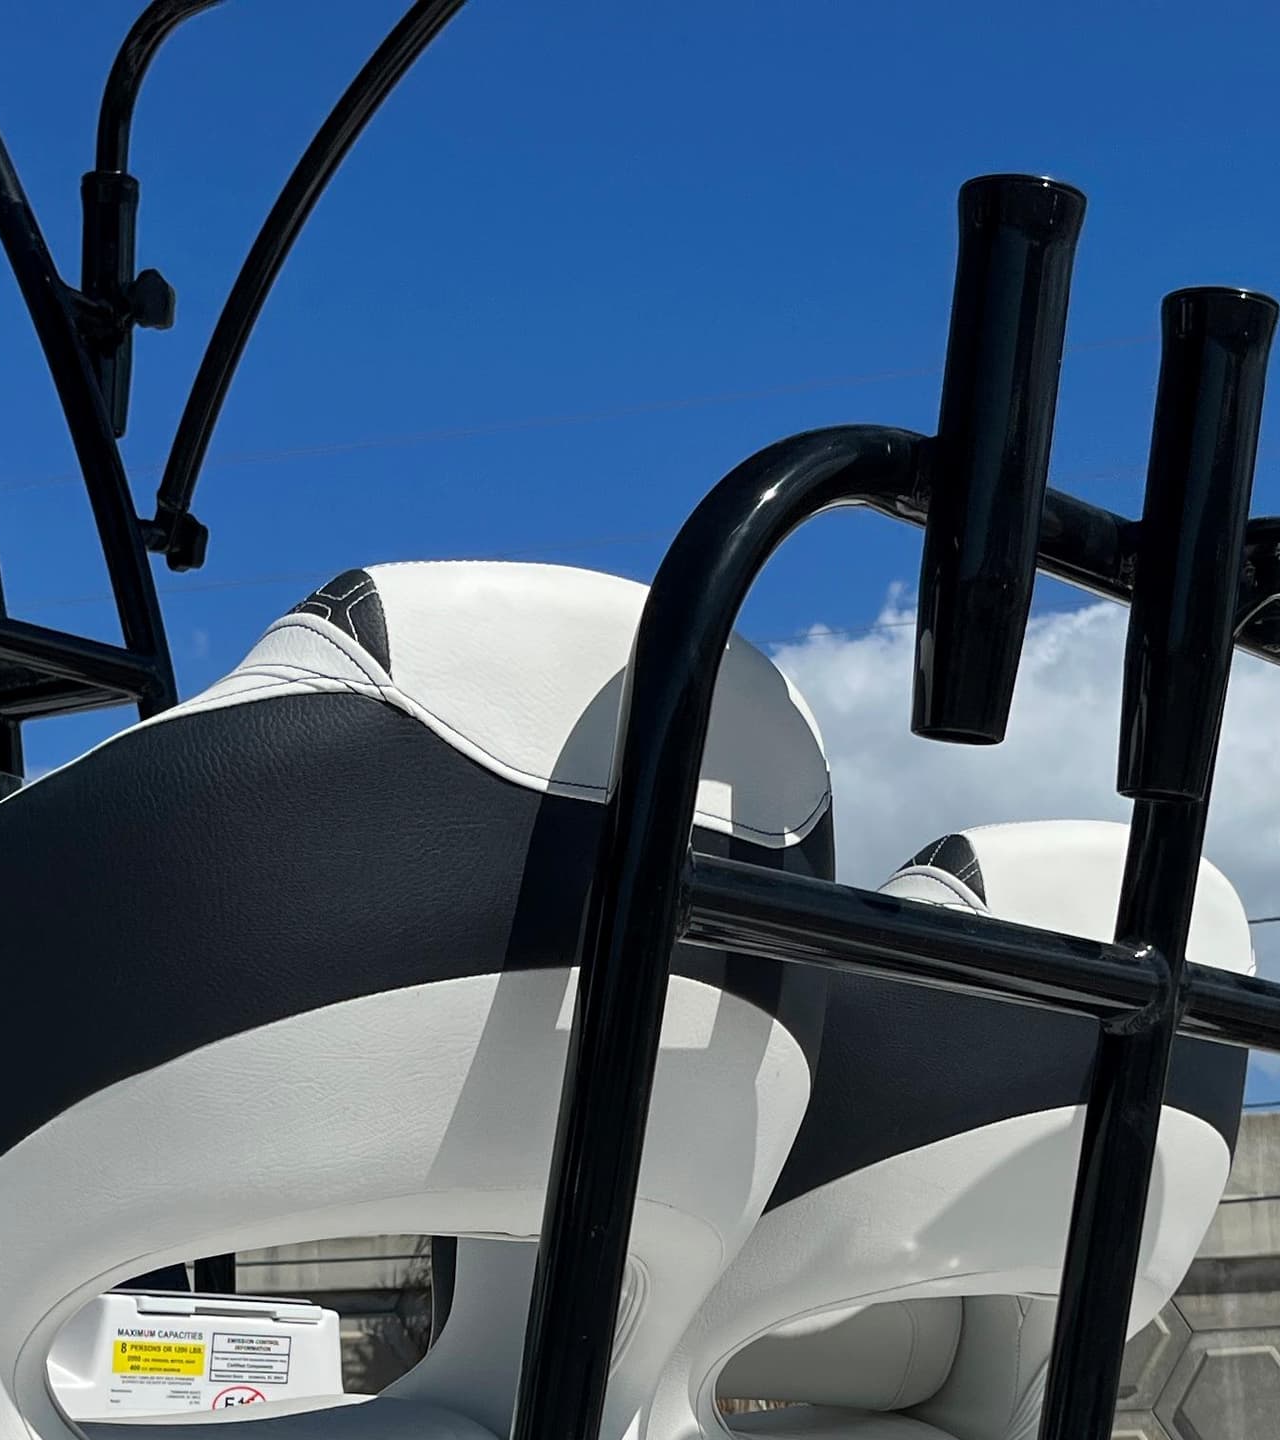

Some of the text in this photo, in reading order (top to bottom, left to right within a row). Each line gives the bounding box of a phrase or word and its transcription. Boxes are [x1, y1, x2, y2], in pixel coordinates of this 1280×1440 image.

[117, 1328, 204, 1340] MAXIMUM CAPACITIES
[121, 1342, 127, 1354] 8
[130, 1344, 161, 1353] PERSONS
